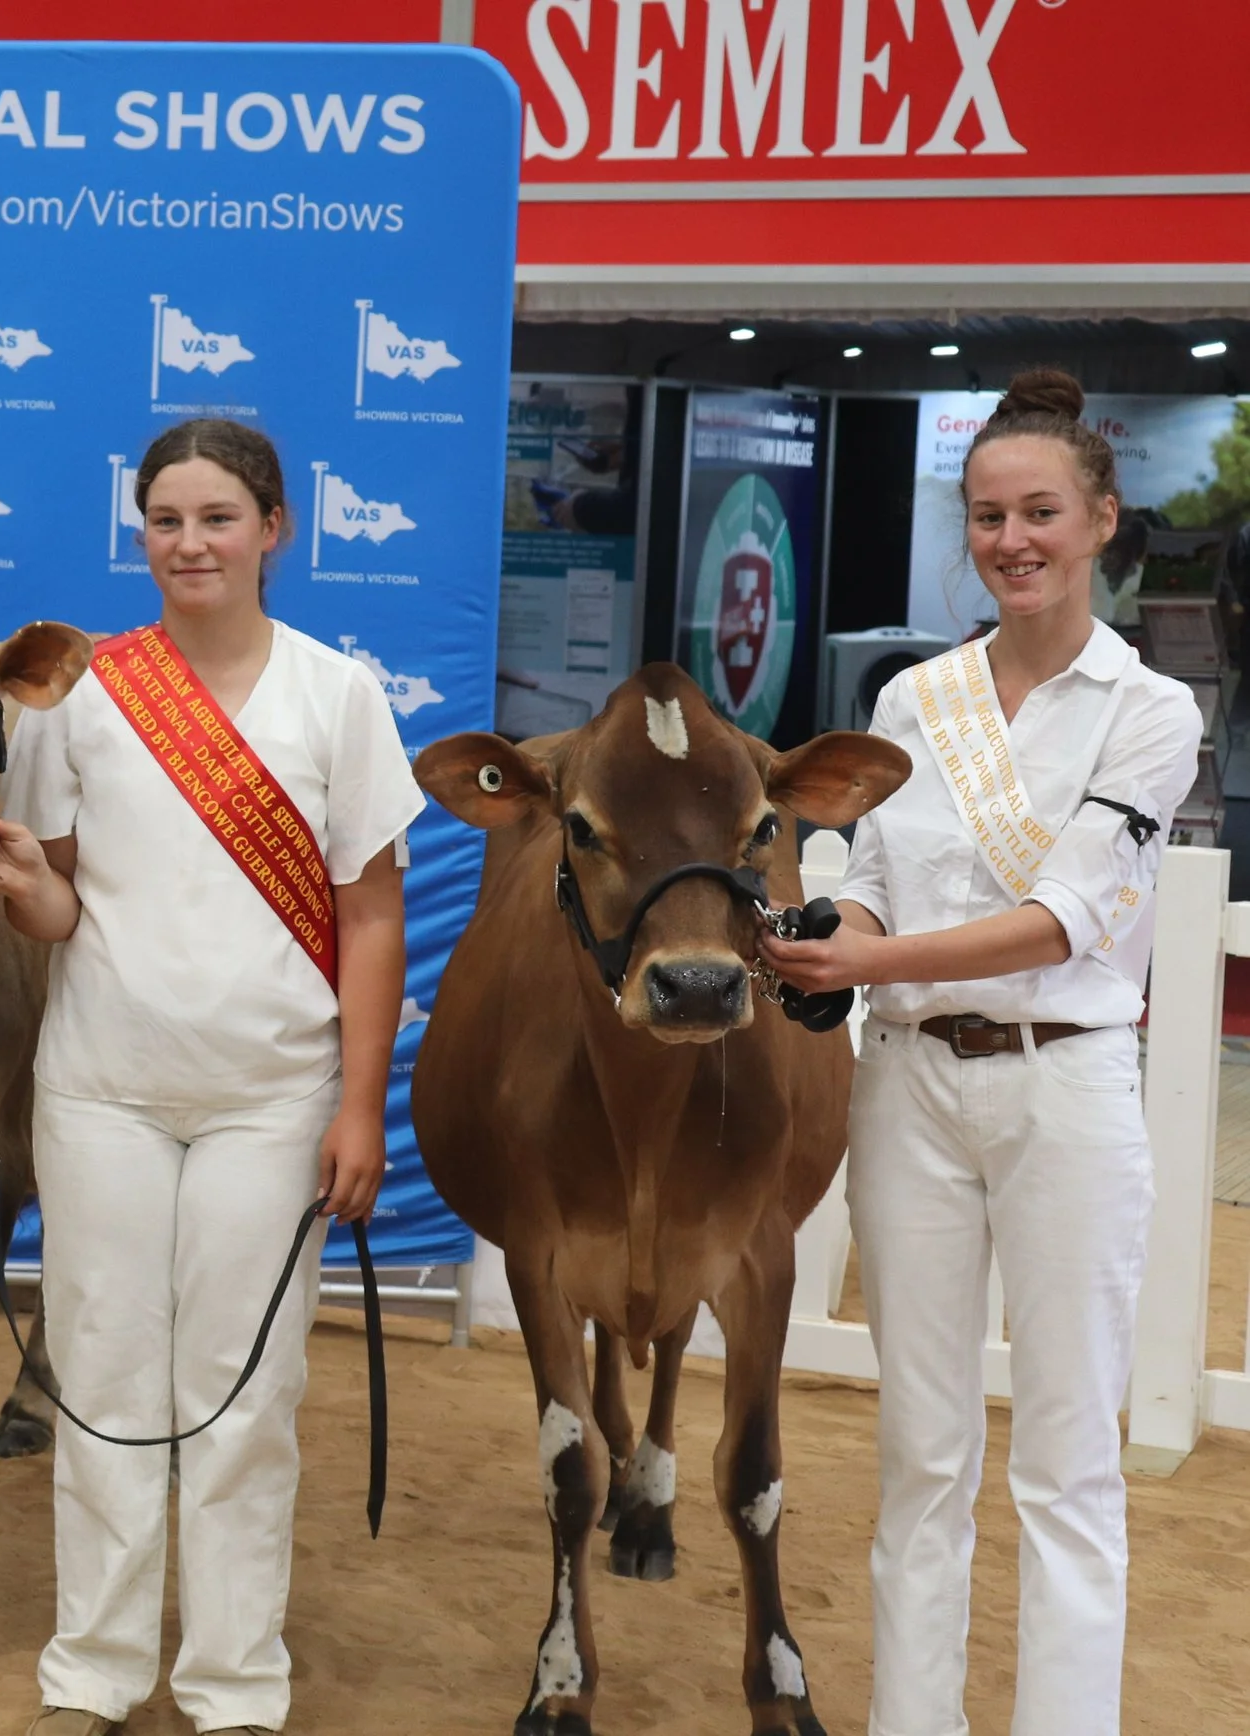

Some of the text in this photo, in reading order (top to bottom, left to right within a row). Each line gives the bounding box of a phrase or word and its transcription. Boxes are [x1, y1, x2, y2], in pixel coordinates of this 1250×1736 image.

[523, 0, 1028, 162] SEMEX
[113, 90, 425, 154] SHOWS
[181, 339, 220, 354] VAS
[386, 345, 425, 360] VAS
[4, 399, 55, 410] VICTORIA
[355, 410, 463, 423] SHOWING VICTORIA
[342, 507, 381, 522] VAS
[109, 563, 151, 574] SHOWIN
[311, 571, 419, 584] SHOWING VICTORIA
[937, 657, 960, 698] STATE
[138, 629, 193, 699] VICTORIAN
[186, 697, 275, 811] AGRICULTURAL
[270, 805, 312, 859] SHOWS
[948, 696, 971, 743] FINAL
[128, 656, 166, 702] STATE
[157, 694, 196, 742] FINAL
[193, 744, 238, 801] DAIRY
[231, 793, 283, 857] CATTLE
[274, 847, 325, 920] PARADING
[933, 728, 953, 754] BY
[944, 754, 993, 848] BLENCOWE
[970, 749, 997, 800] DAIRY
[974, 700, 1022, 818] AGRICULTURAL
[1019, 815, 1057, 850] SHO
[96, 654, 324, 955] SPONSORED BY BLENCOWE GUERNSEY GOLD
[988, 801, 1035, 865] CATTLE
